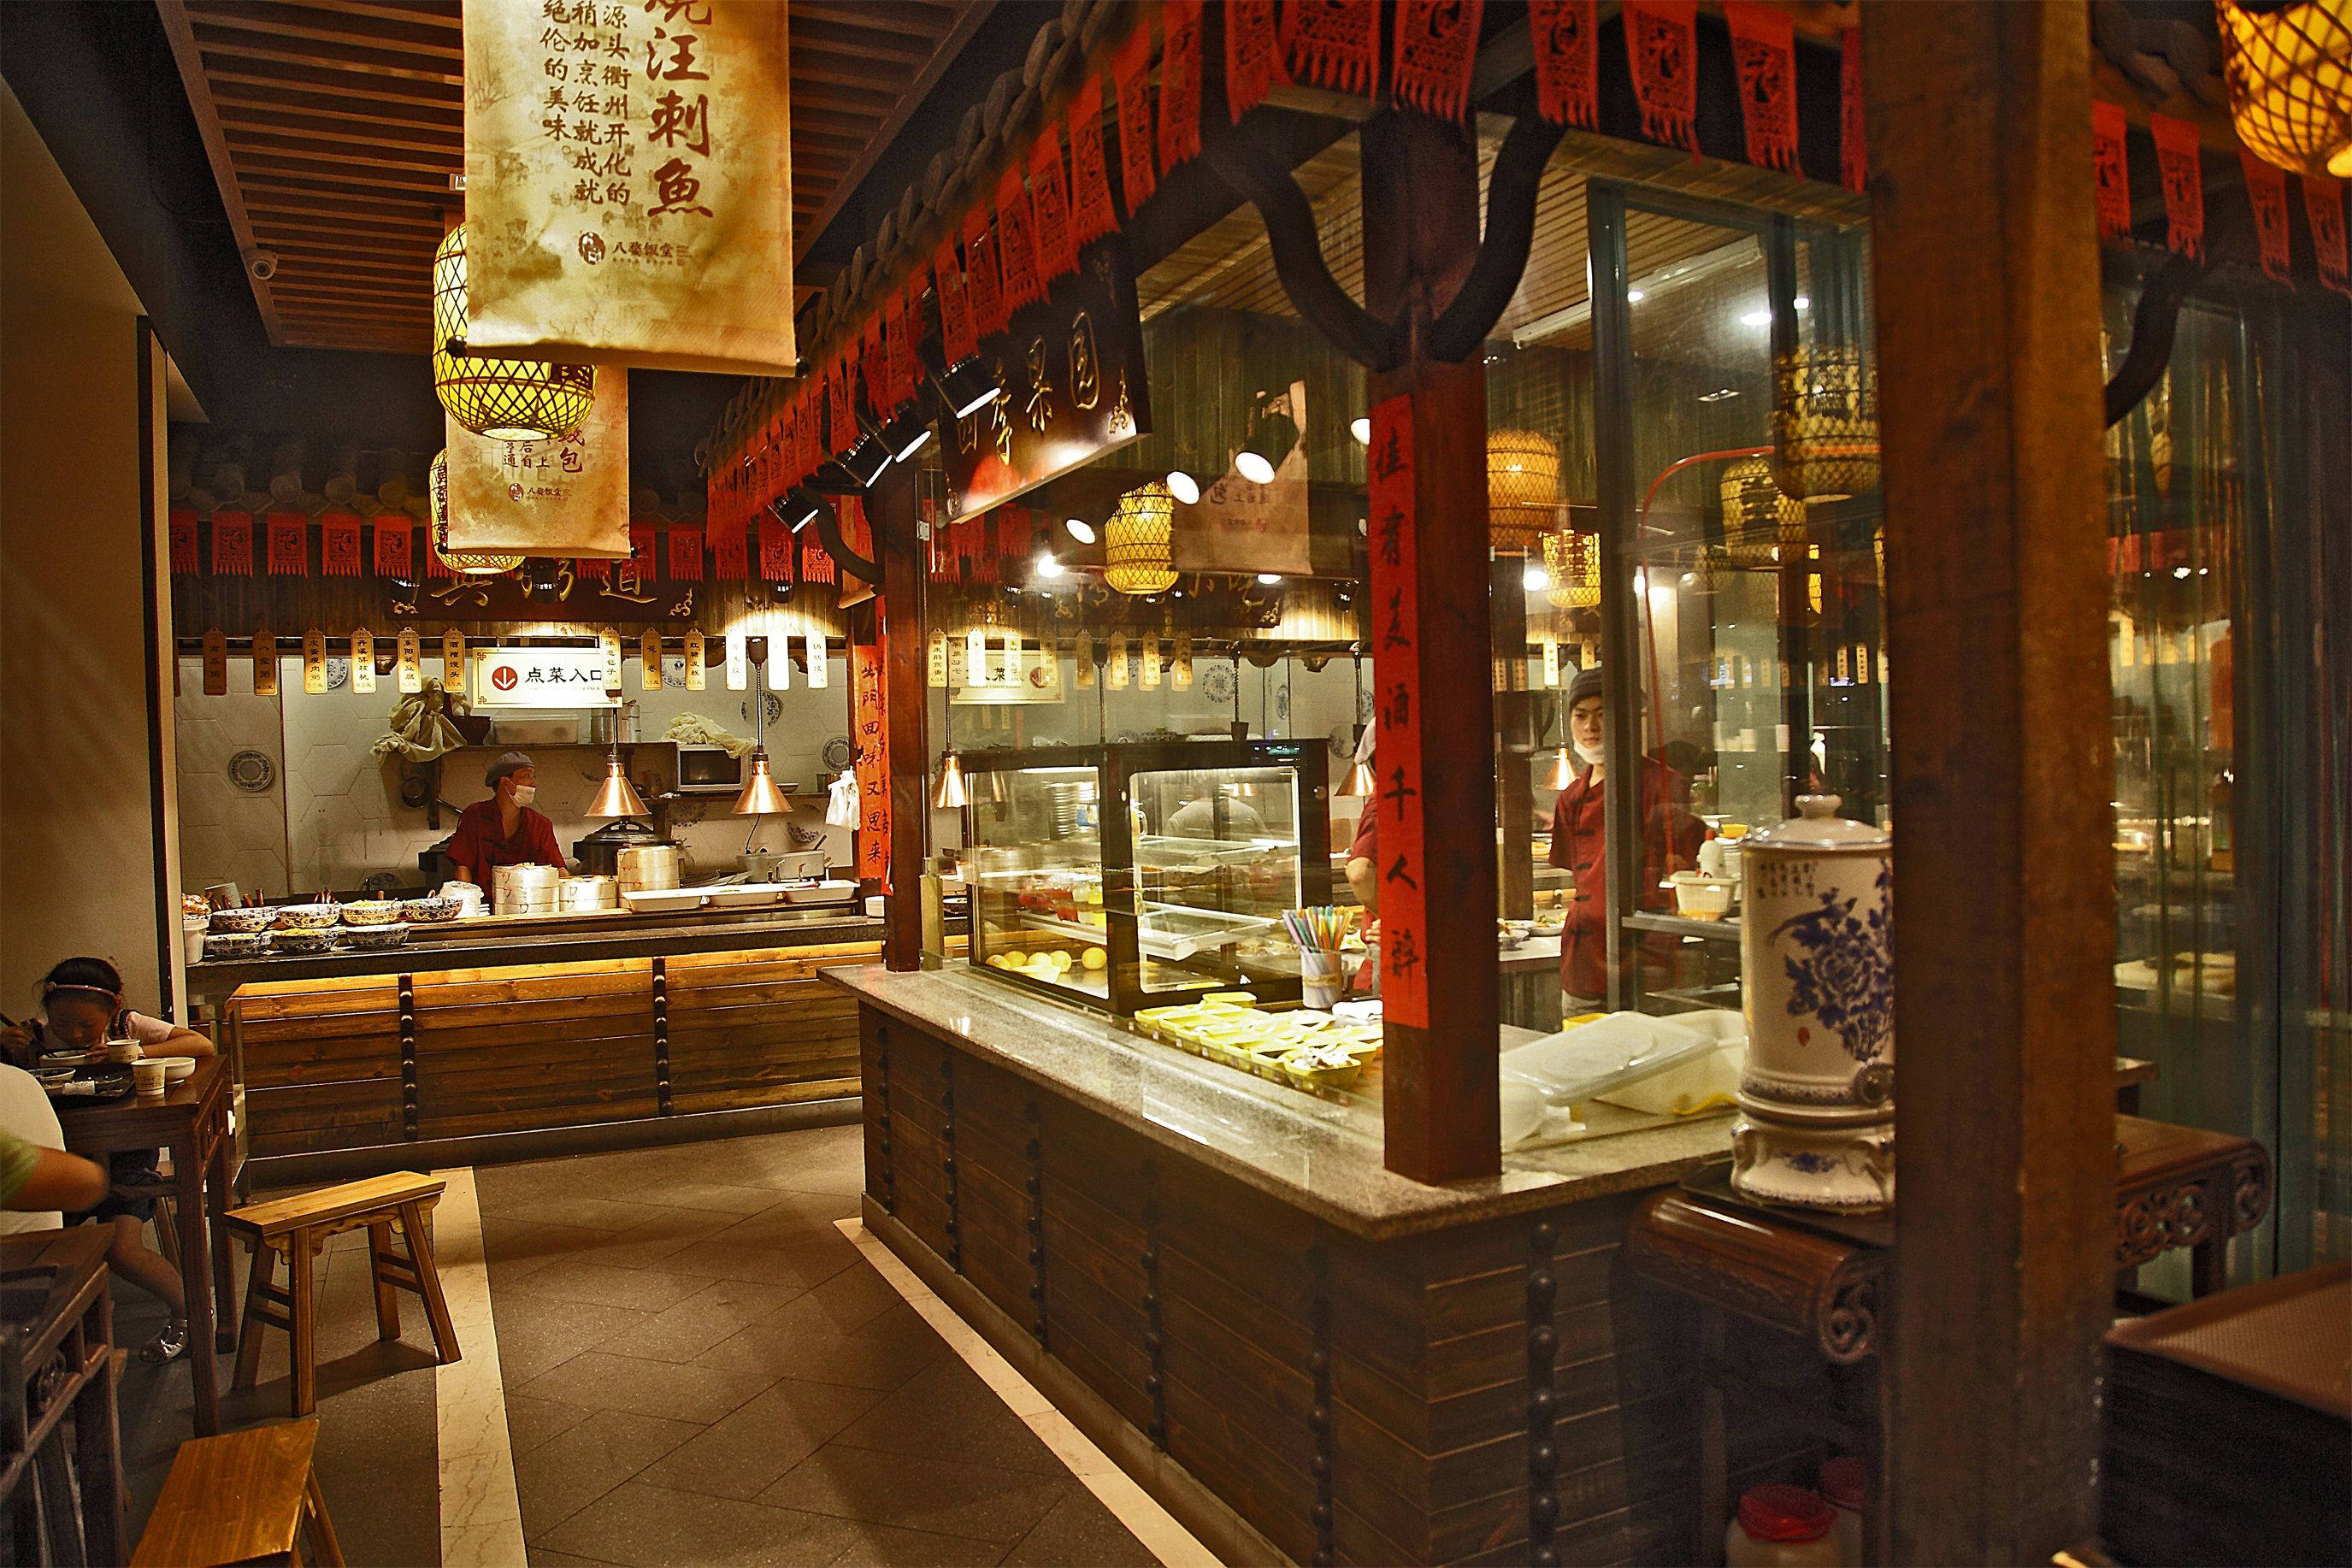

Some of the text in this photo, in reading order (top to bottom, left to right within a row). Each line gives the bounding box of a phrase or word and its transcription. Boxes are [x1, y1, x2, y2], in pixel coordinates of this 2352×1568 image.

[601, 5, 631, 206] 源头衢州开化的
[525, 667, 602, 683] 点菜入口
